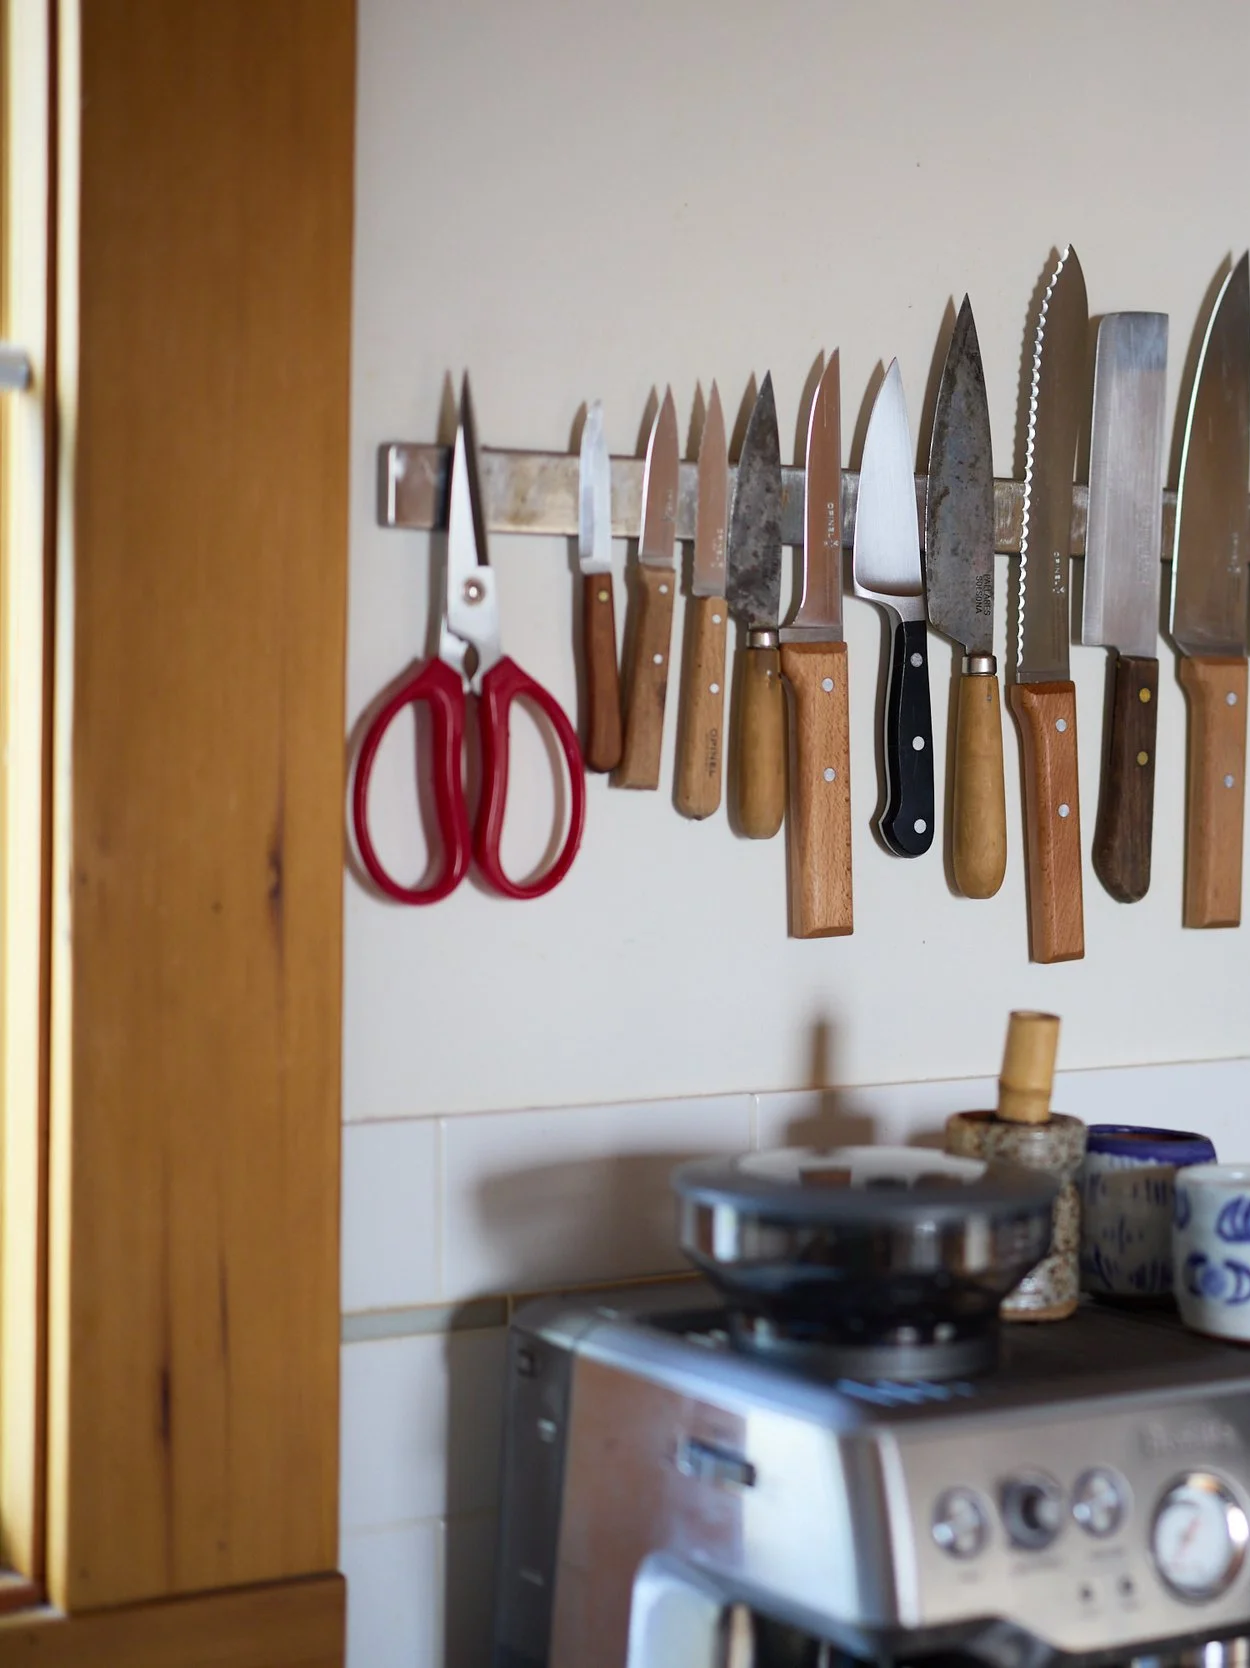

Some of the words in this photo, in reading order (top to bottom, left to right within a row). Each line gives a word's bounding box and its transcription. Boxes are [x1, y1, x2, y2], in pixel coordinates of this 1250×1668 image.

[827, 502, 835, 538] OPINEL
[975, 575, 983, 614] SOLSONA
[983, 573, 992, 616] PALLARES
[709, 728, 718, 777] OPINEL
